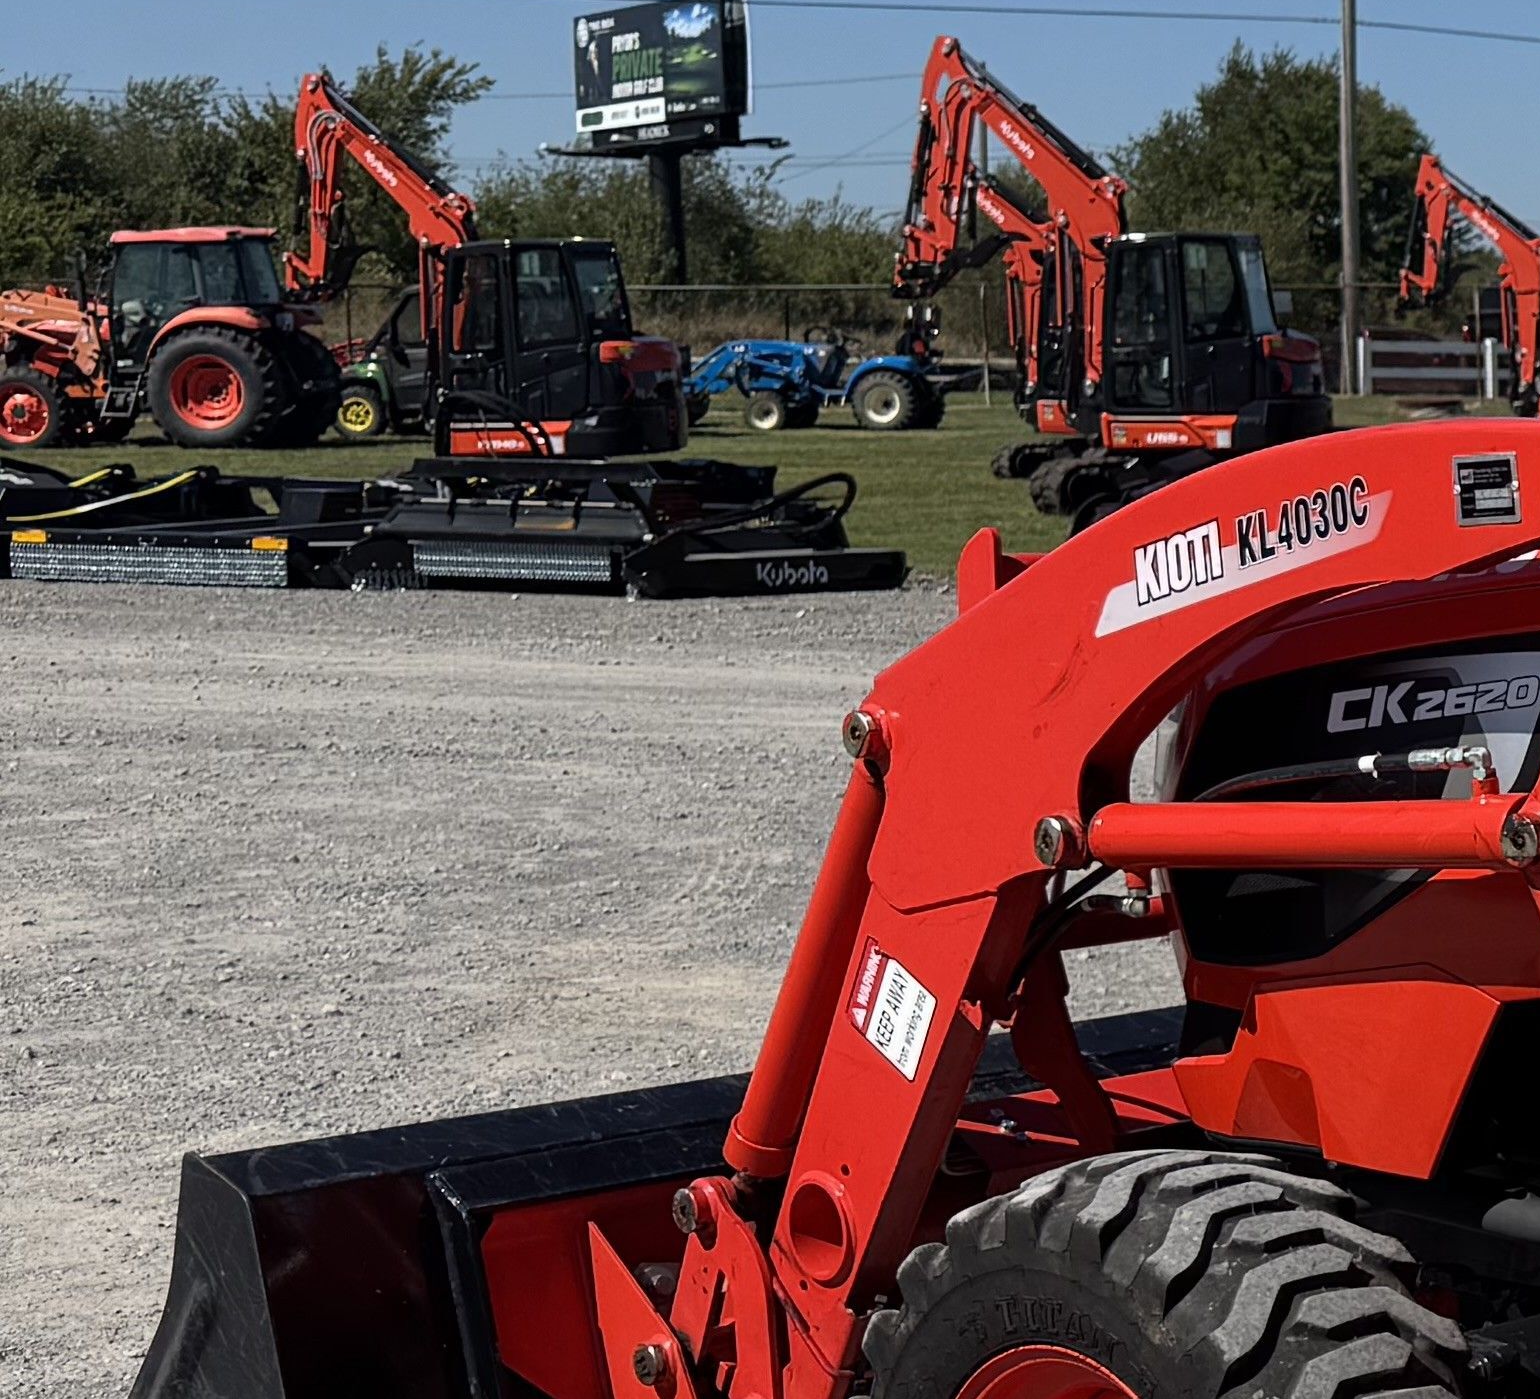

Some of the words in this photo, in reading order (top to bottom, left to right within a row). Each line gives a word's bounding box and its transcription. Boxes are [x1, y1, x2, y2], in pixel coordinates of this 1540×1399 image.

[612, 47, 664, 82] PRIVATE
[1134, 519, 1223, 606] KIOTI
[1236, 475, 1370, 570] KL4030C
[756, 559, 829, 588] Kubota
[1326, 675, 1540, 734] CK2620
[856, 945, 883, 1007] WARNING
[874, 1010, 895, 1051] KEEP
[885, 967, 909, 1016] AWAY
